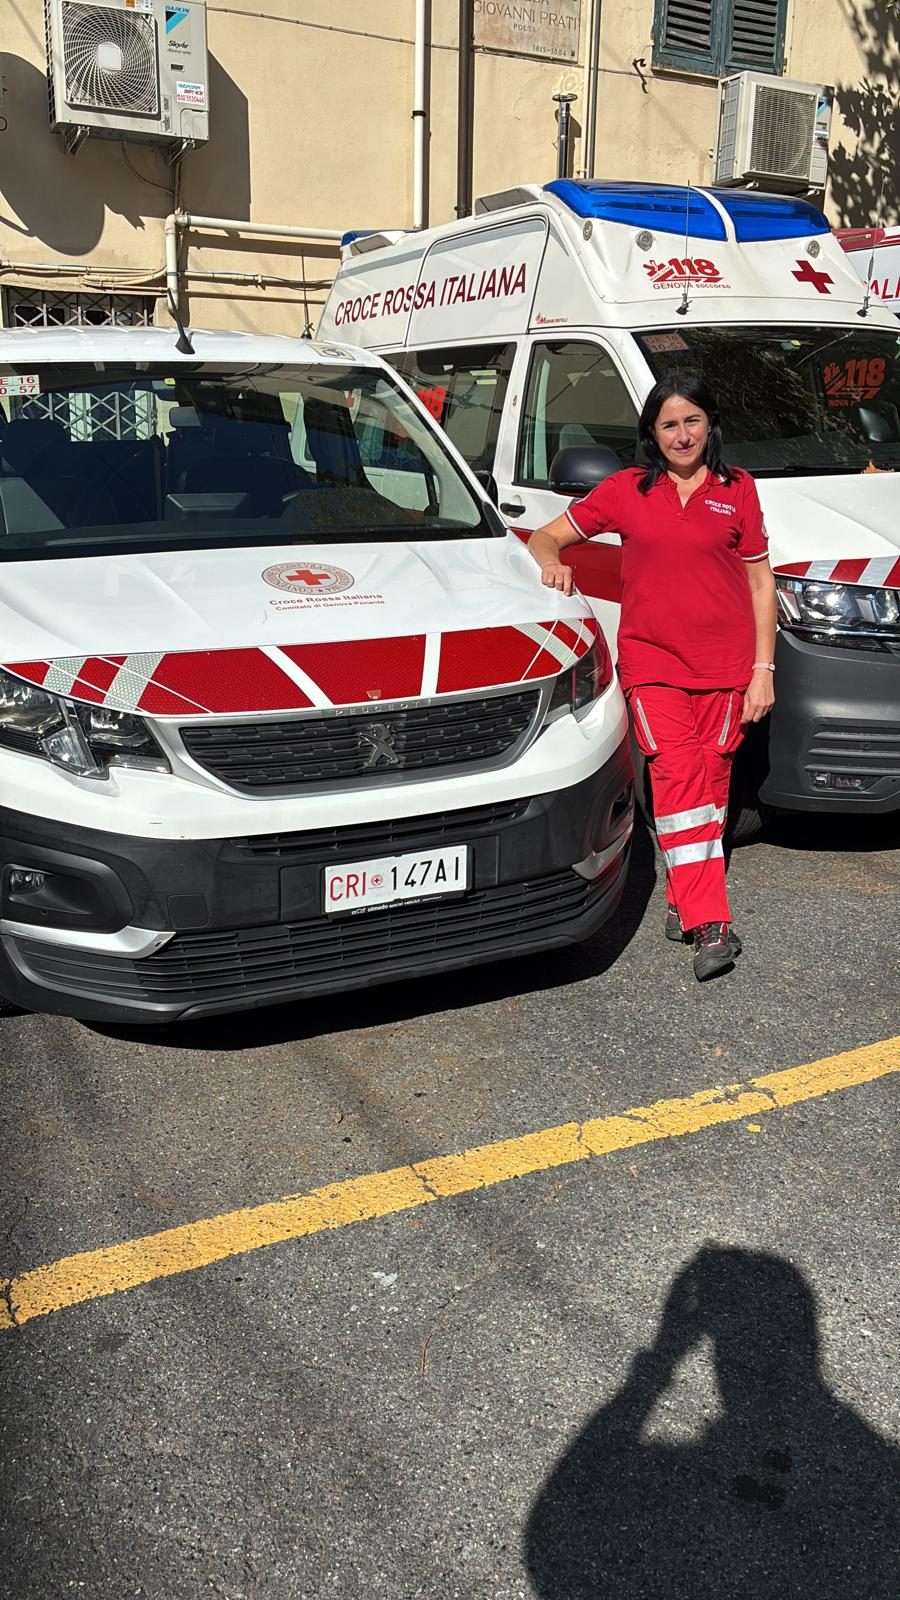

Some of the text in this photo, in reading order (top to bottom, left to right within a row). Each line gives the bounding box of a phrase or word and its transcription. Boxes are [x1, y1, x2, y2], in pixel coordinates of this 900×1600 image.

[165, 5, 190, 13] DAIKIN
[474, 0, 578, 31] GIOVANNI PRATI
[668, 258, 720, 276] 118
[653, 282, 693, 290] GENOVA
[334, 263, 527, 327] CROCE ROSSA ITALIANA
[845, 358, 886, 387] 118
[18, 376, 36, 385] 16
[704, 499, 722, 508] CROCE
[269, 598, 304, 606] Croce
[343, 593, 384, 601] Italiana
[329, 856, 460, 902] CRI 147AI
